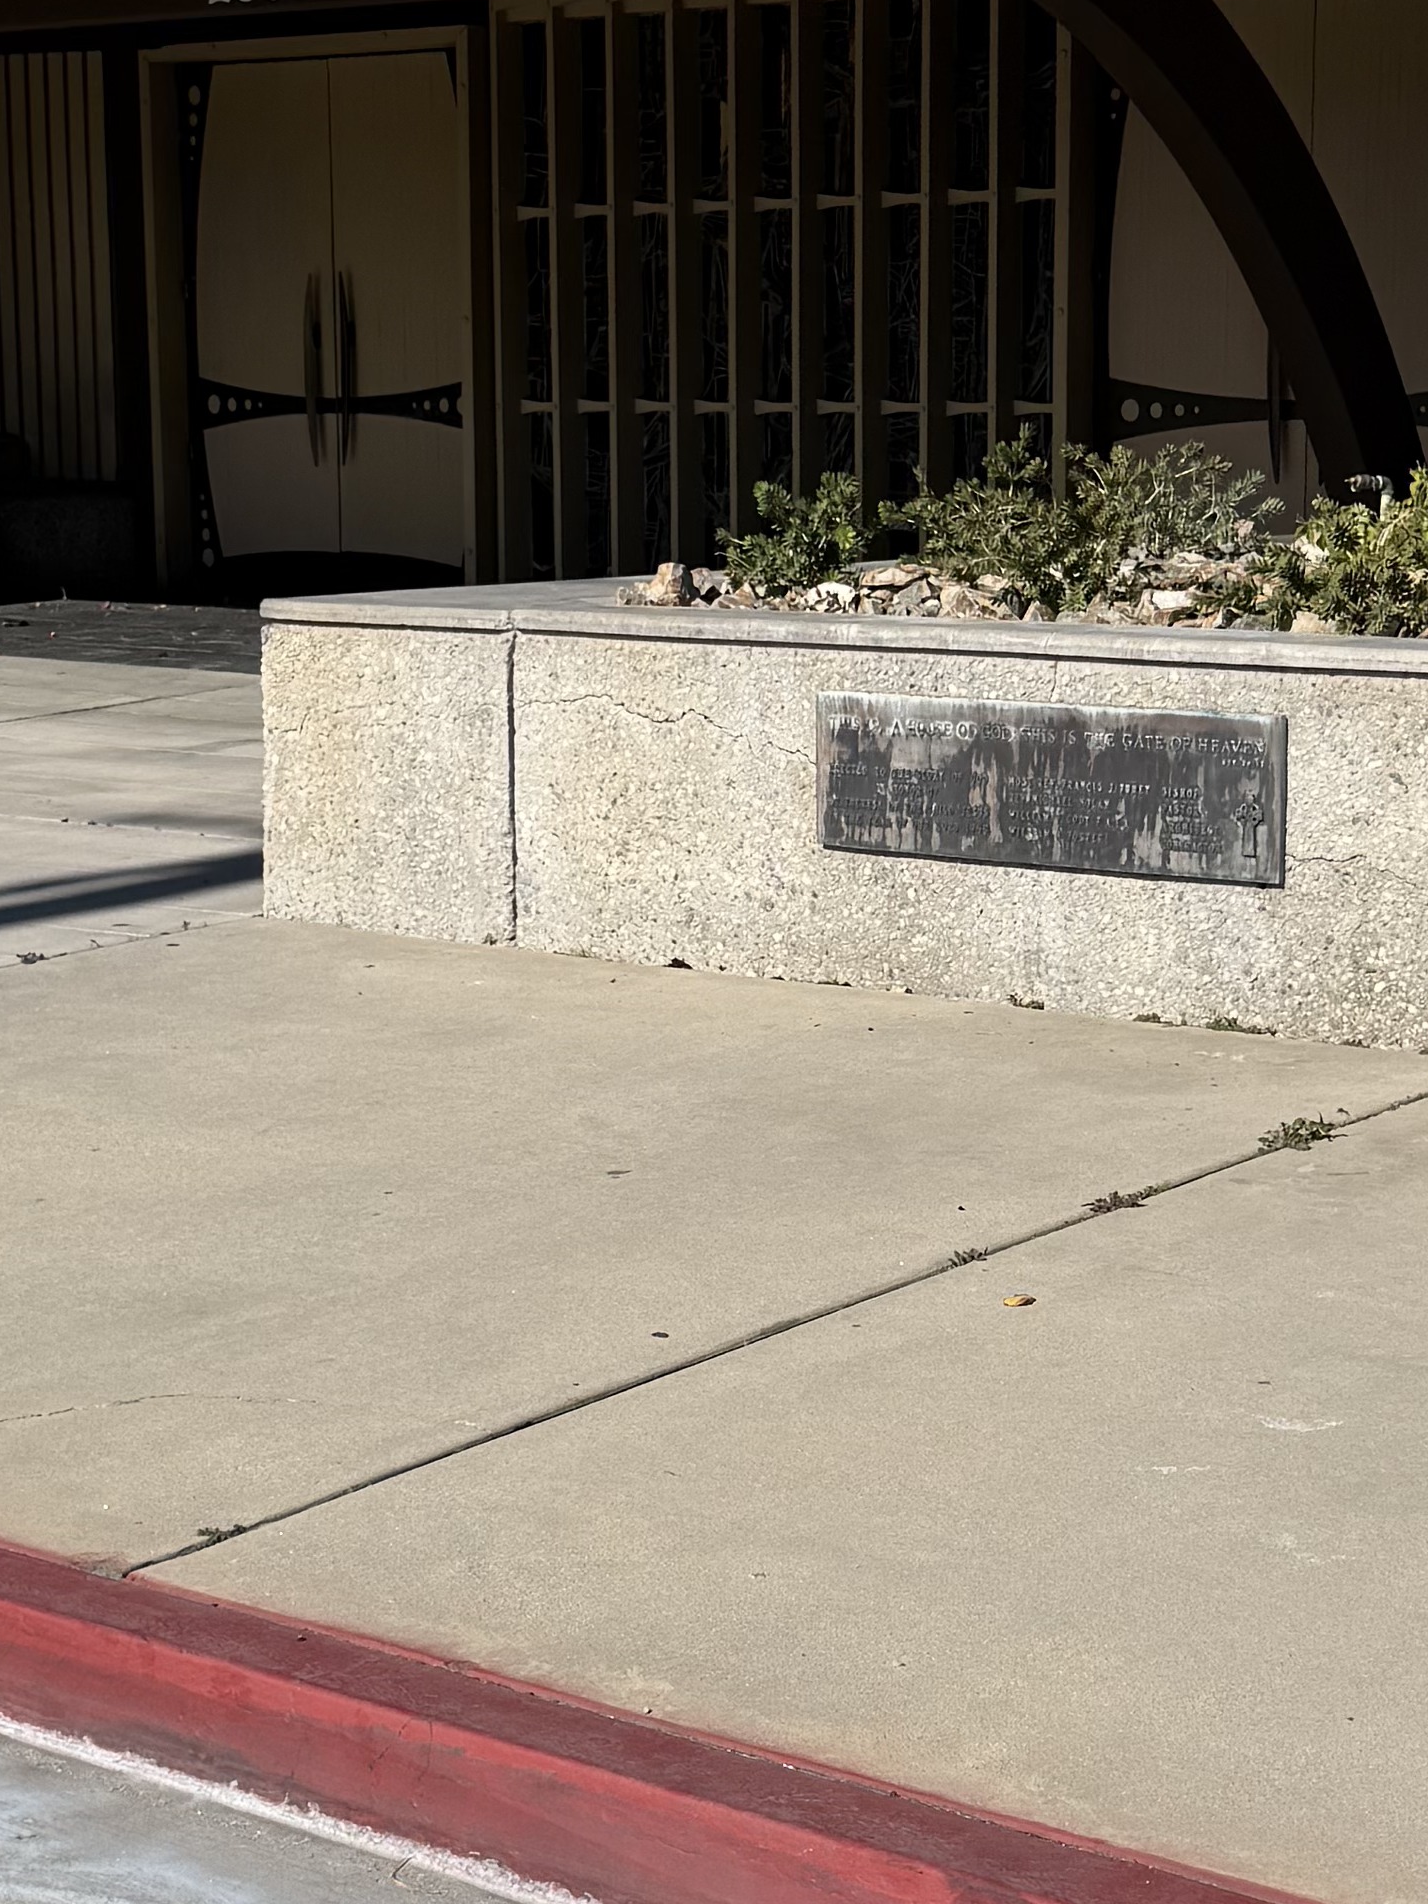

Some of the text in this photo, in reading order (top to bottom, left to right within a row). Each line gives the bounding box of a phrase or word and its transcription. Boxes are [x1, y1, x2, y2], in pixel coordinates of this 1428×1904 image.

[890, 717, 906, 738] A
[1019, 724, 1056, 745] THIS
[1062, 728, 1077, 745] IS
[1083, 731, 1116, 749] THE
[1121, 733, 1165, 752] GATE
[1169, 735, 1191, 752] OF
[1197, 737, 1266, 755] HEAVEN
